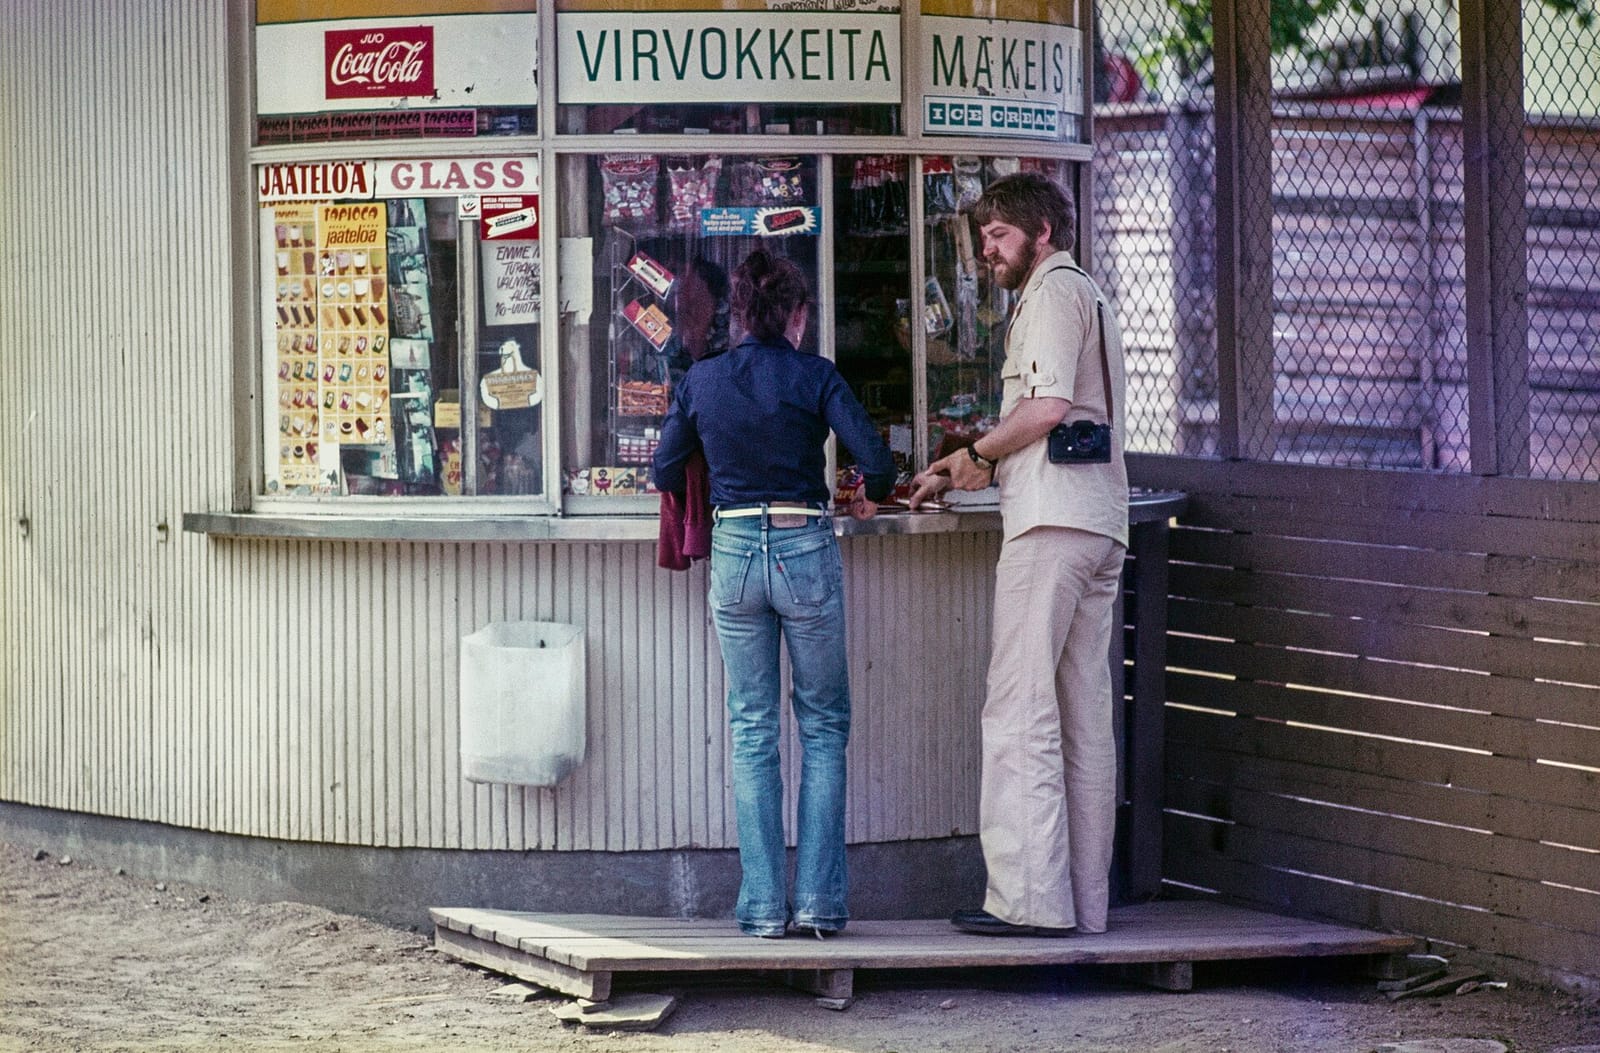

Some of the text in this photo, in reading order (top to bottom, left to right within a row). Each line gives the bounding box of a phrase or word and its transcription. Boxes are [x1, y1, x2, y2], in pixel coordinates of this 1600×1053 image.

[360, 33, 384, 44] JUO
[576, 27, 892, 82] VIRVOKKEITA
[931, 104, 1057, 129] ICE CREAM
[261, 161, 368, 196] JÄÄTELÖÄ
[390, 160, 525, 191] GLASS
[323, 206, 379, 222] TAPIOCA
[496, 245, 531, 260] EMME
